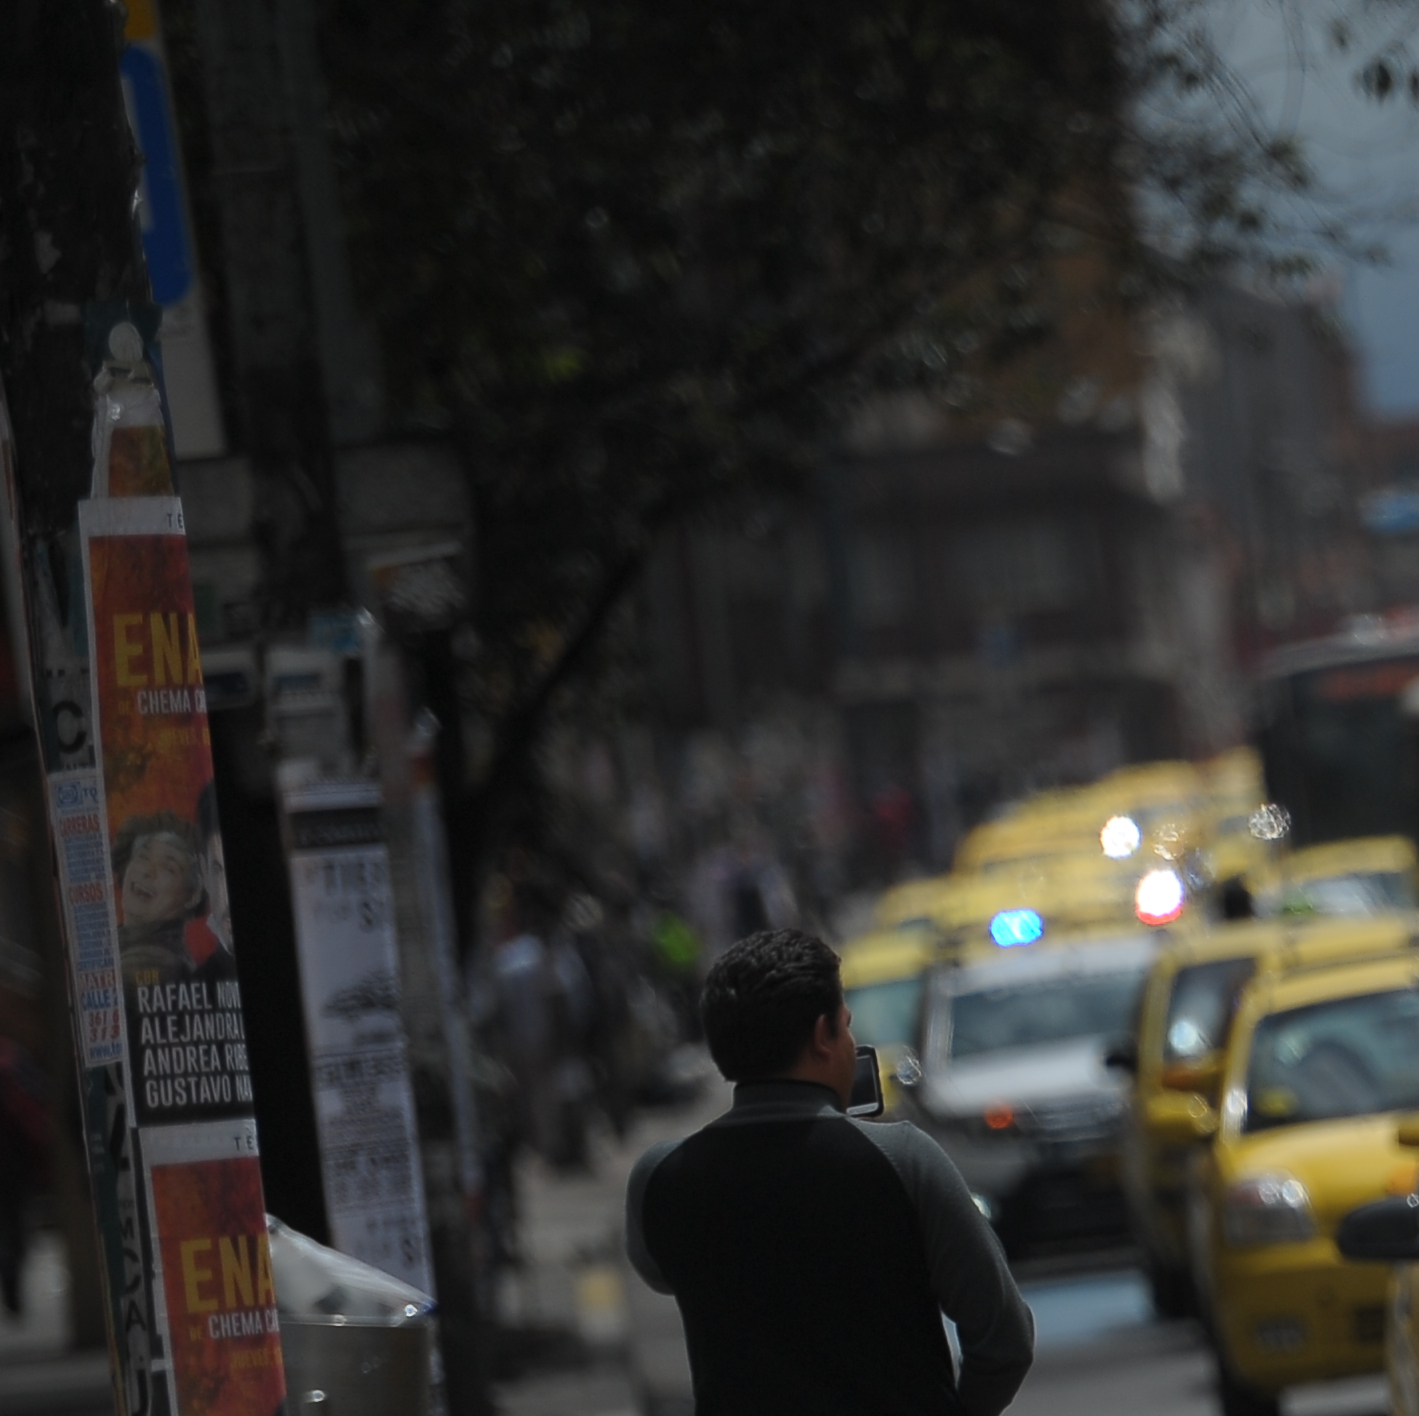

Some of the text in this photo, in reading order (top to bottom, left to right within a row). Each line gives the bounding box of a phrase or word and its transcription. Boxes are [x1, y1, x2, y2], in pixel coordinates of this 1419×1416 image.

[137, 688, 192, 715] CHEMA
[135, 970, 160, 985] CON
[136, 982, 213, 1014] RAFAEL
[140, 1012, 239, 1045] ALEJANDRA
[143, 1044, 222, 1077] ANDREA
[146, 1074, 232, 1109] GUSTAVO
[208, 1311, 264, 1340] CHEMA
